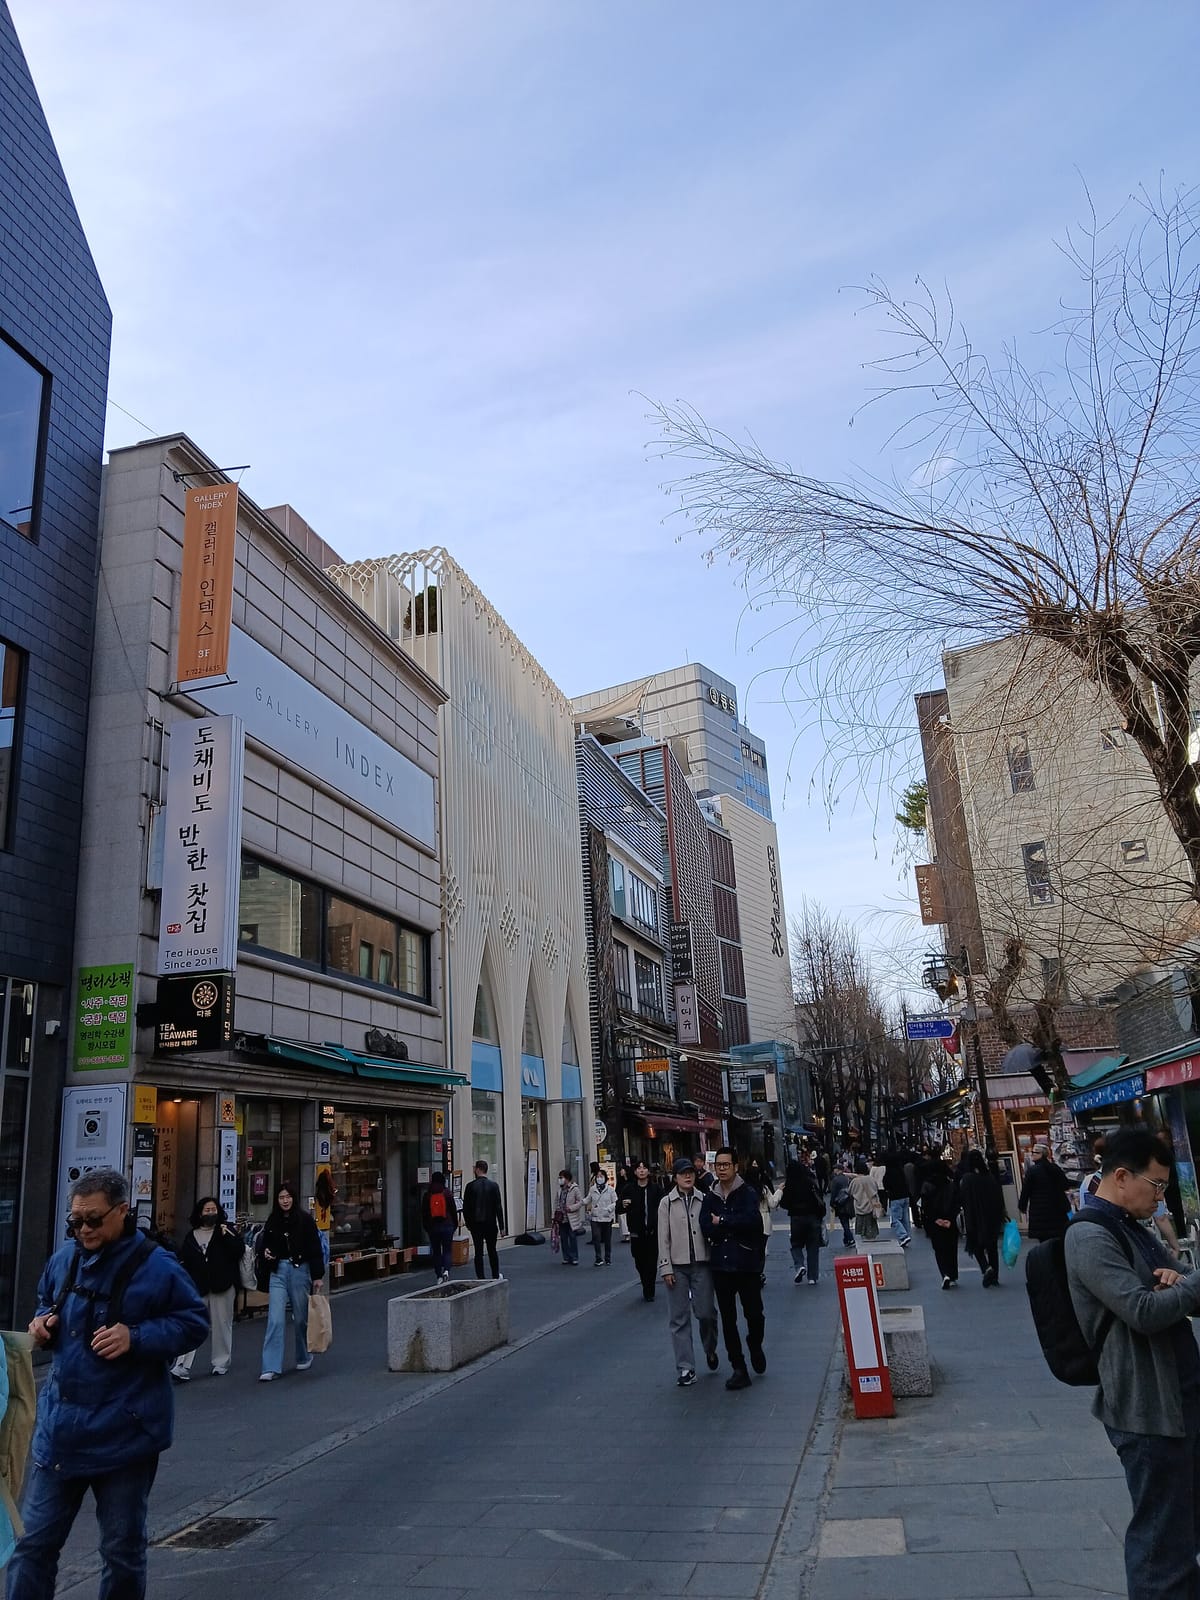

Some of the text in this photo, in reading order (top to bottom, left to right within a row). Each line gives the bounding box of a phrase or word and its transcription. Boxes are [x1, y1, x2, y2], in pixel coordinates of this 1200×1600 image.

[194, 491, 229, 503] GALLERY
[200, 500, 222, 510] INDEX
[203, 521, 217, 567] 갤러리
[255, 686, 394, 796] GALLERY INDEX
[179, 726, 215, 934] 도채비도 반한 찻집
[165, 947, 218, 959] Tea House
[164, 957, 218, 970] Since 2011
[160, 1023, 175, 1032] TEA
[160, 1030, 198, 1040] TEAWARE
[842, 1267, 864, 1277] 사용법
